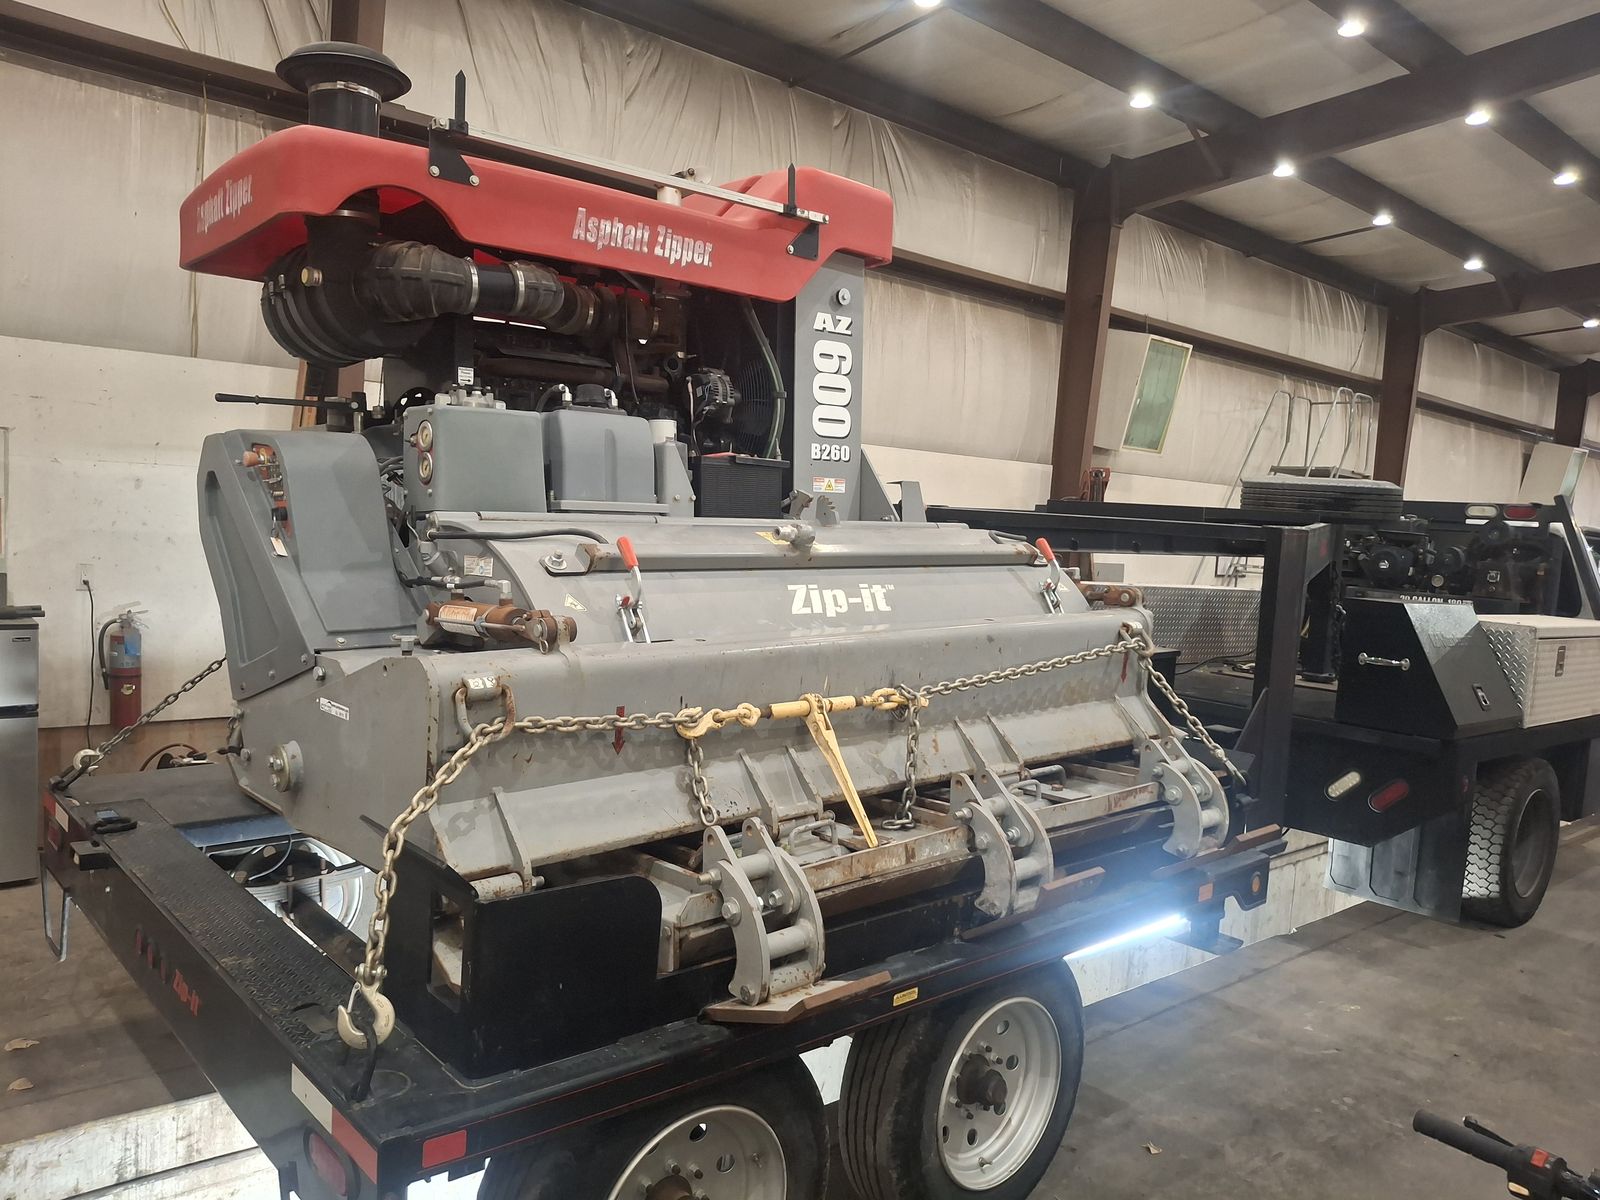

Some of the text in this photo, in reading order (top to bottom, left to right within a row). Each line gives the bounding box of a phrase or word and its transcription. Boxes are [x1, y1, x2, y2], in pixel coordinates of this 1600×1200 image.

[572, 207, 650, 253] Asphalt
[813, 312, 852, 336] AZ
[812, 339, 852, 438] 600
[811, 443, 850, 462] B260
